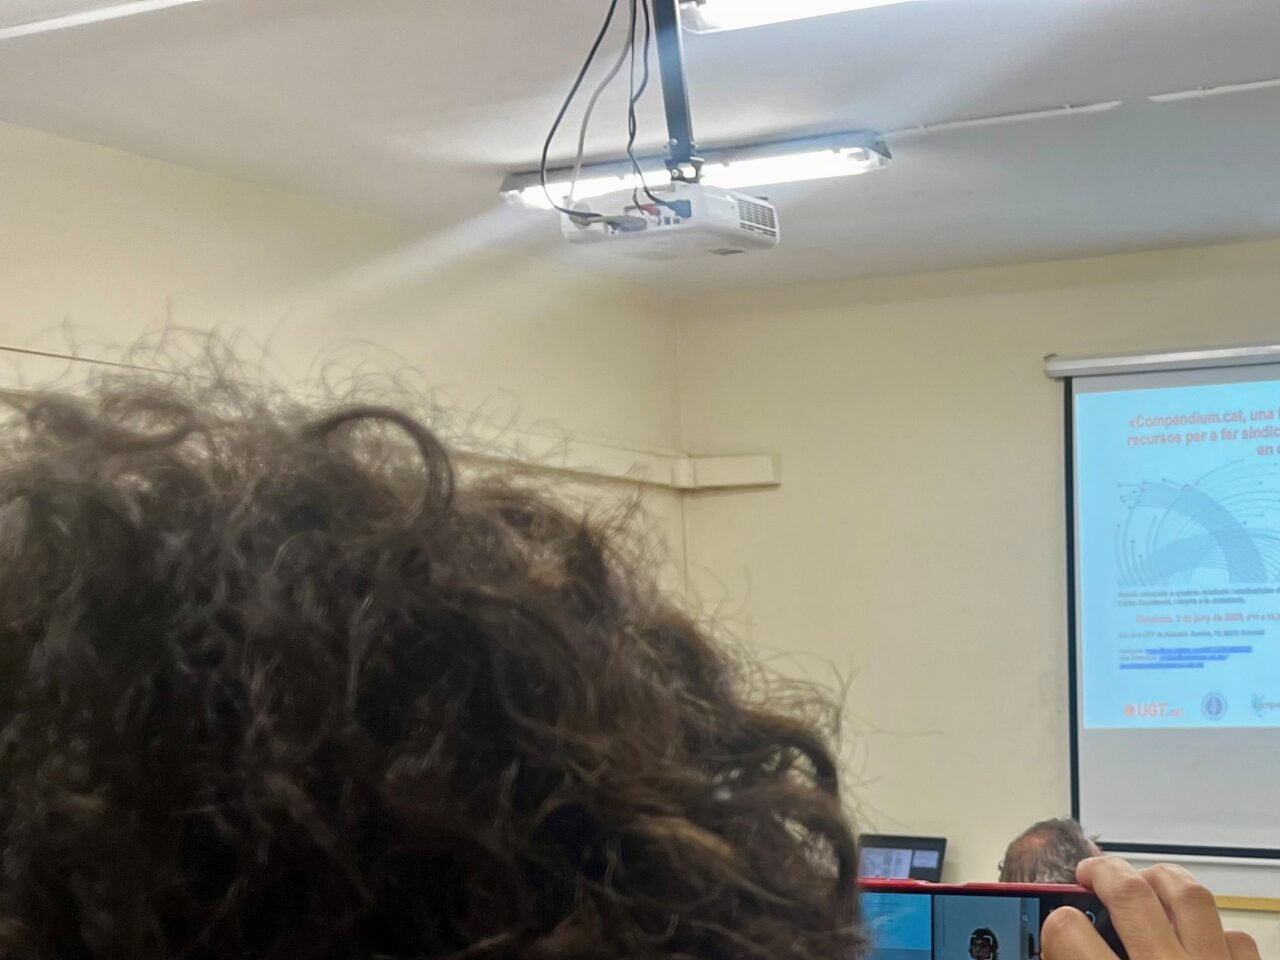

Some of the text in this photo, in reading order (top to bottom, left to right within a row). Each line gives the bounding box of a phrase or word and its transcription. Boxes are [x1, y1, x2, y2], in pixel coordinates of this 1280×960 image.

[1250, 409, 1274, 422] una
[1128, 432, 1182, 446] recursos
[1186, 431, 1206, 445] per
[1209, 431, 1217, 441] a
[1221, 427, 1238, 440] fer
[1257, 445, 1273, 456] en
